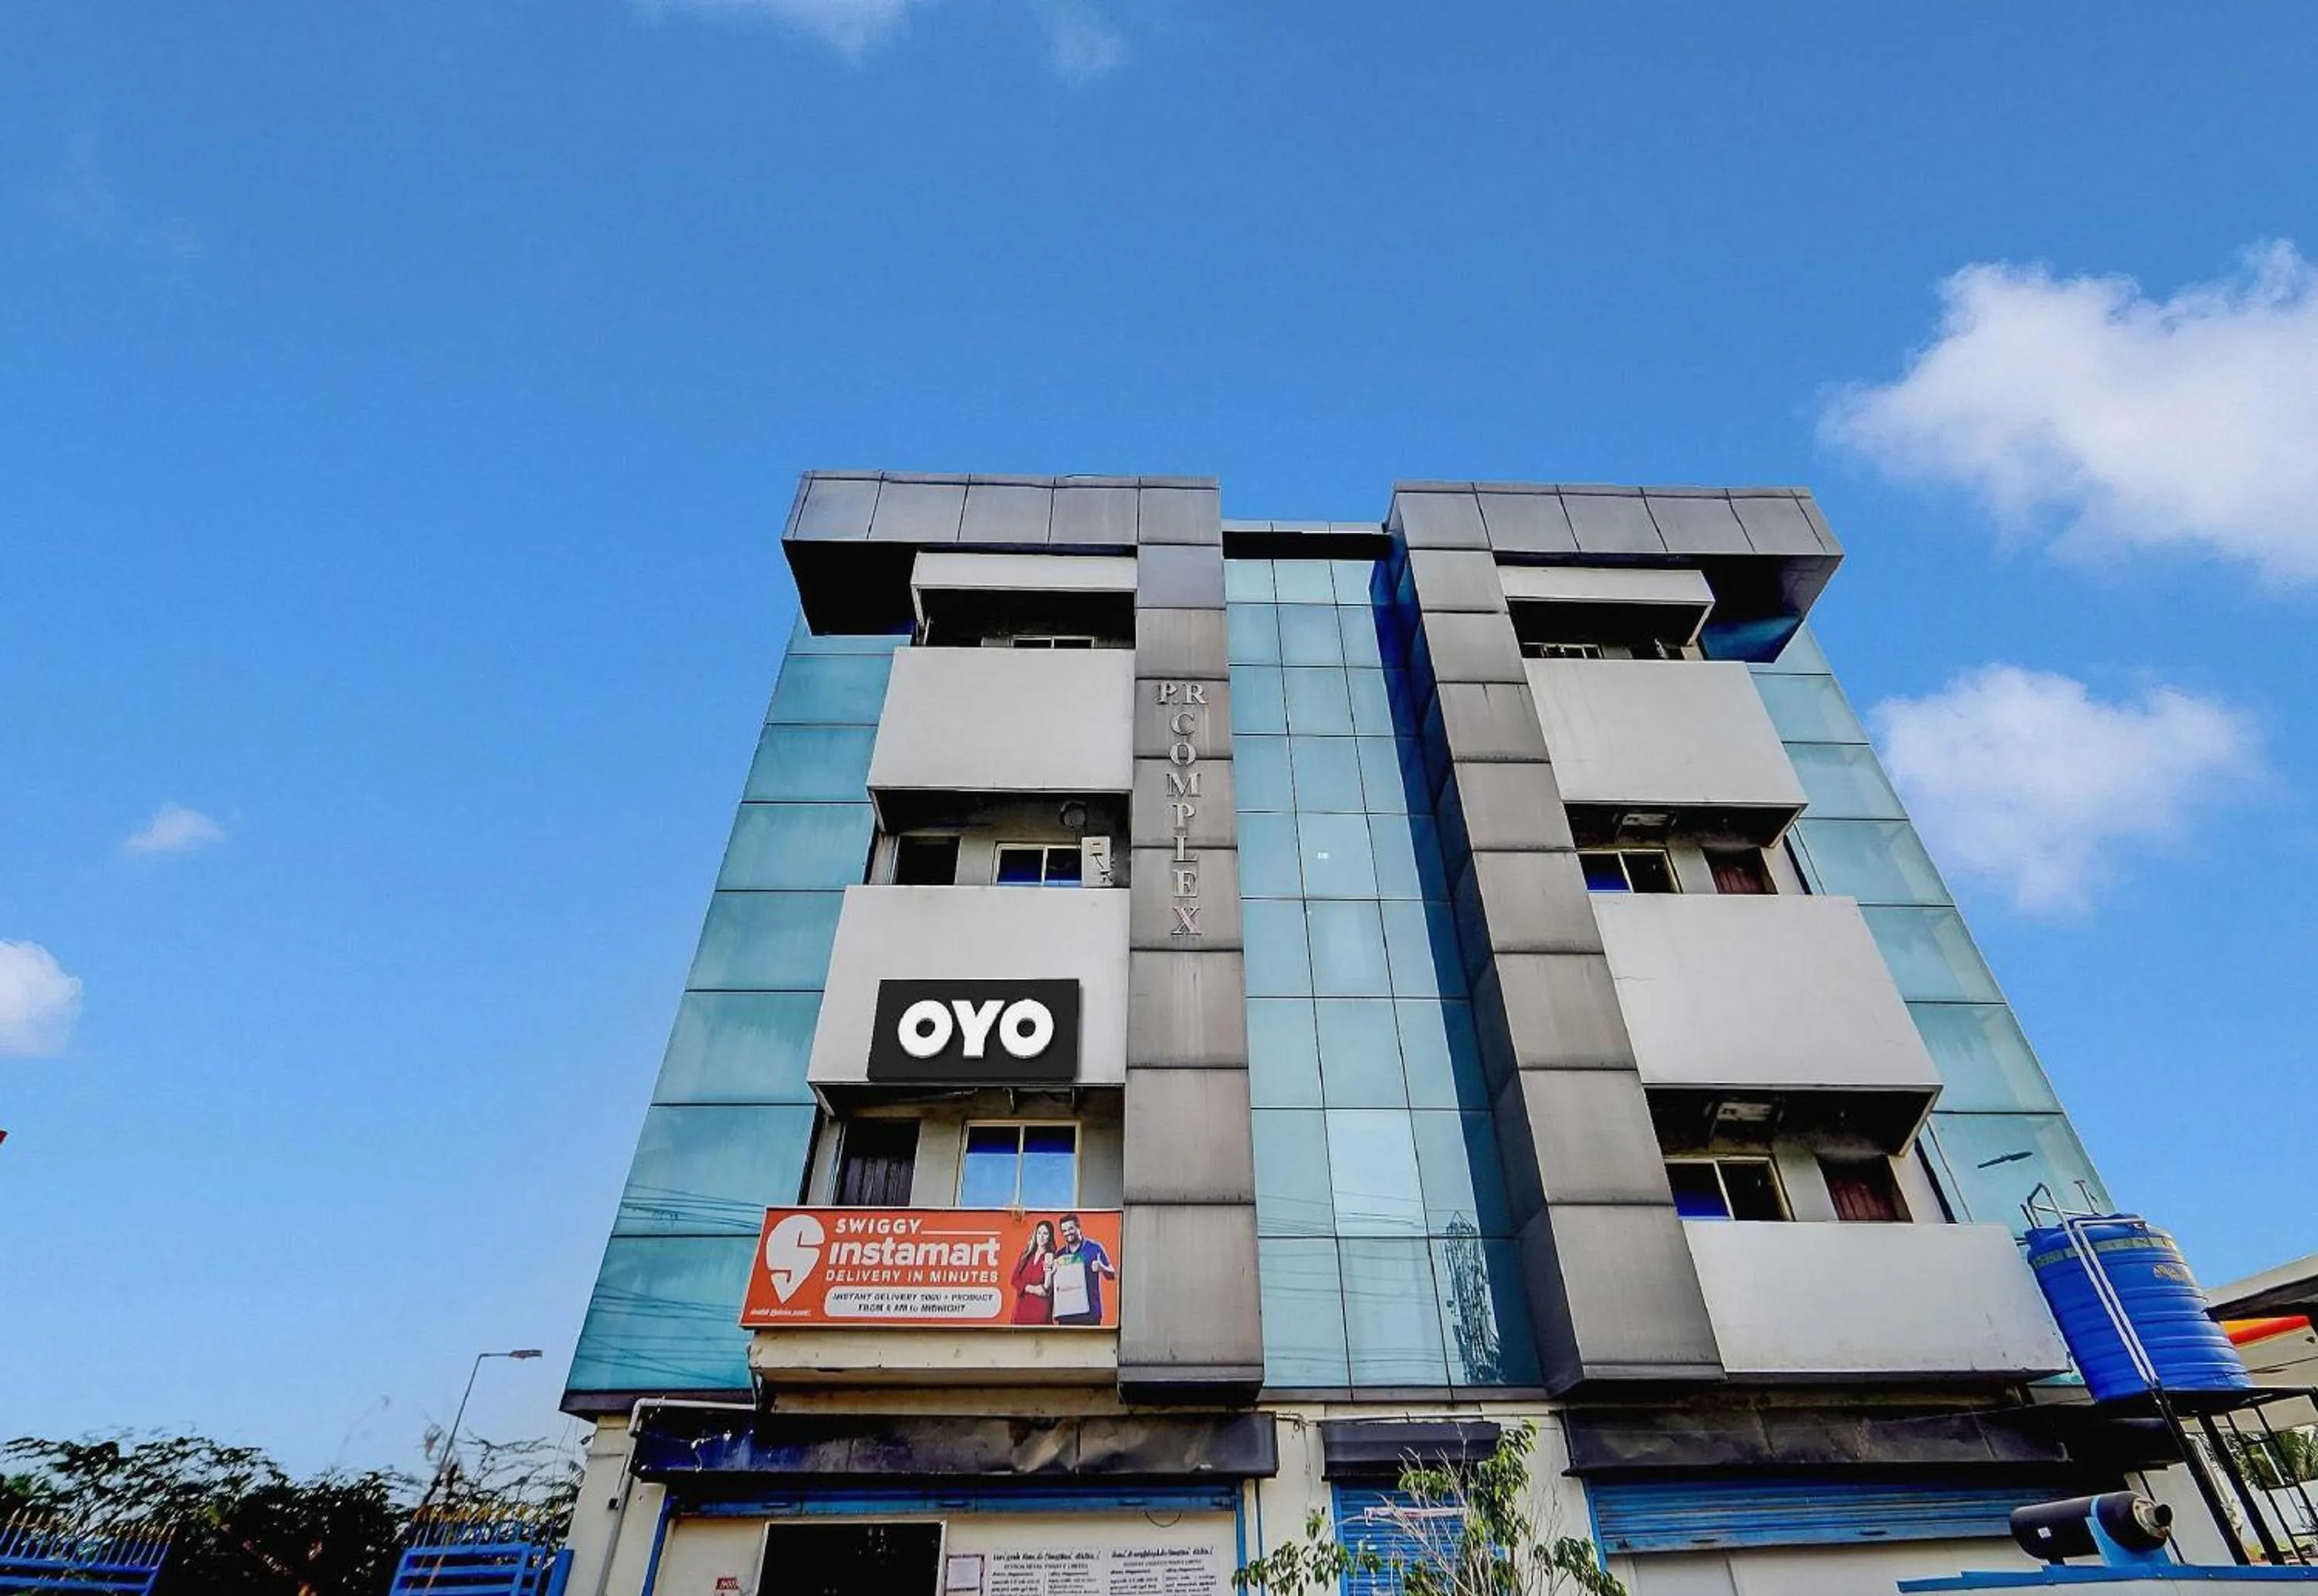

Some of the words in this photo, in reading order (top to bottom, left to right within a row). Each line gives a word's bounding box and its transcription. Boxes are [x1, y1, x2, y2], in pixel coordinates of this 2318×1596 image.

[1165, 711, 1201, 936] COMPLEX
[897, 999, 1054, 1058] OYO
[835, 1217, 923, 1234] SWIGGY
[828, 1237, 1001, 1266] instamart
[826, 1269, 901, 1282] DELIVERY
[907, 1271, 924, 1282] IN
[930, 1271, 999, 1283] MINUTES
[874, 1292, 917, 1301] DELIVERY
[858, 1302, 883, 1312] FROM
[894, 1303, 908, 1312] AM
[920, 1303, 965, 1312] MIDNIGHT
